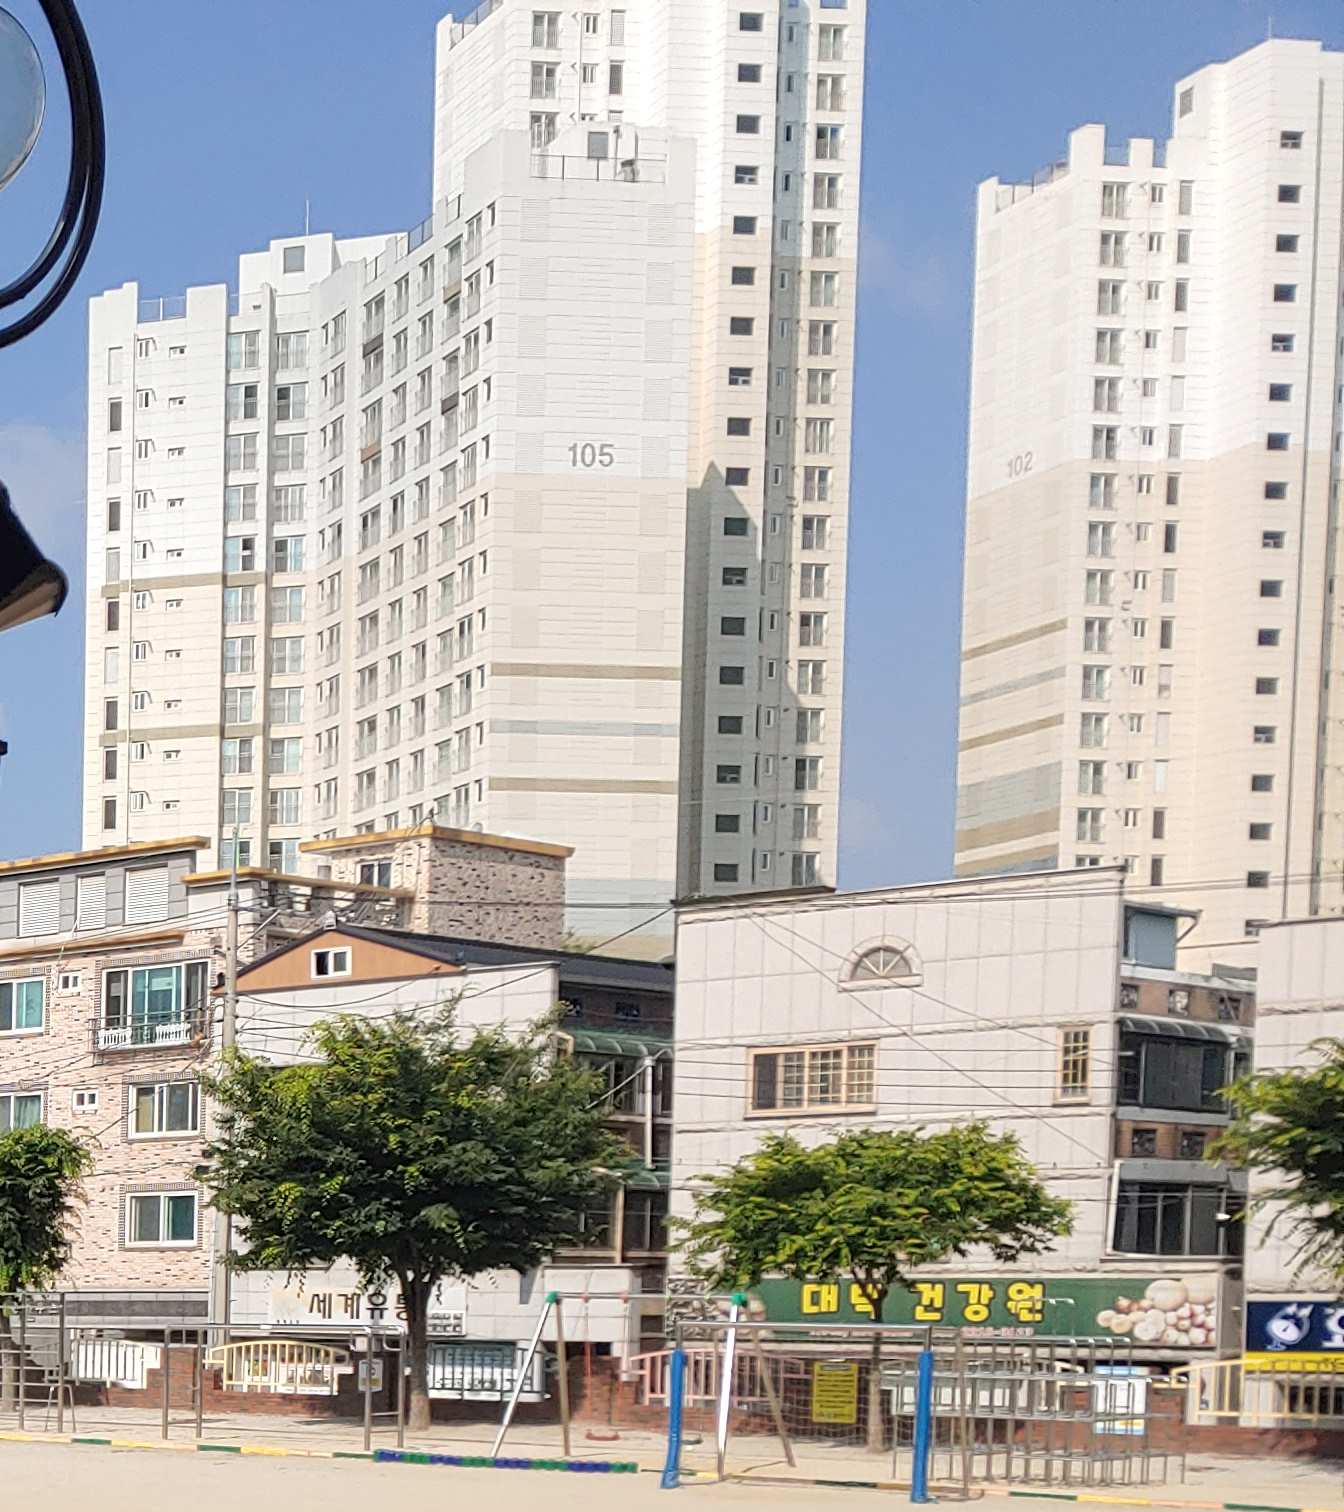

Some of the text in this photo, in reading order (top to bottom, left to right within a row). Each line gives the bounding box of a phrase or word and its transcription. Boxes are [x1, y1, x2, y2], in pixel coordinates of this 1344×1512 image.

[568, 443, 614, 467] 105
[1008, 451, 1033, 478] 102
[911, 1281, 1045, 1322] 건강원
